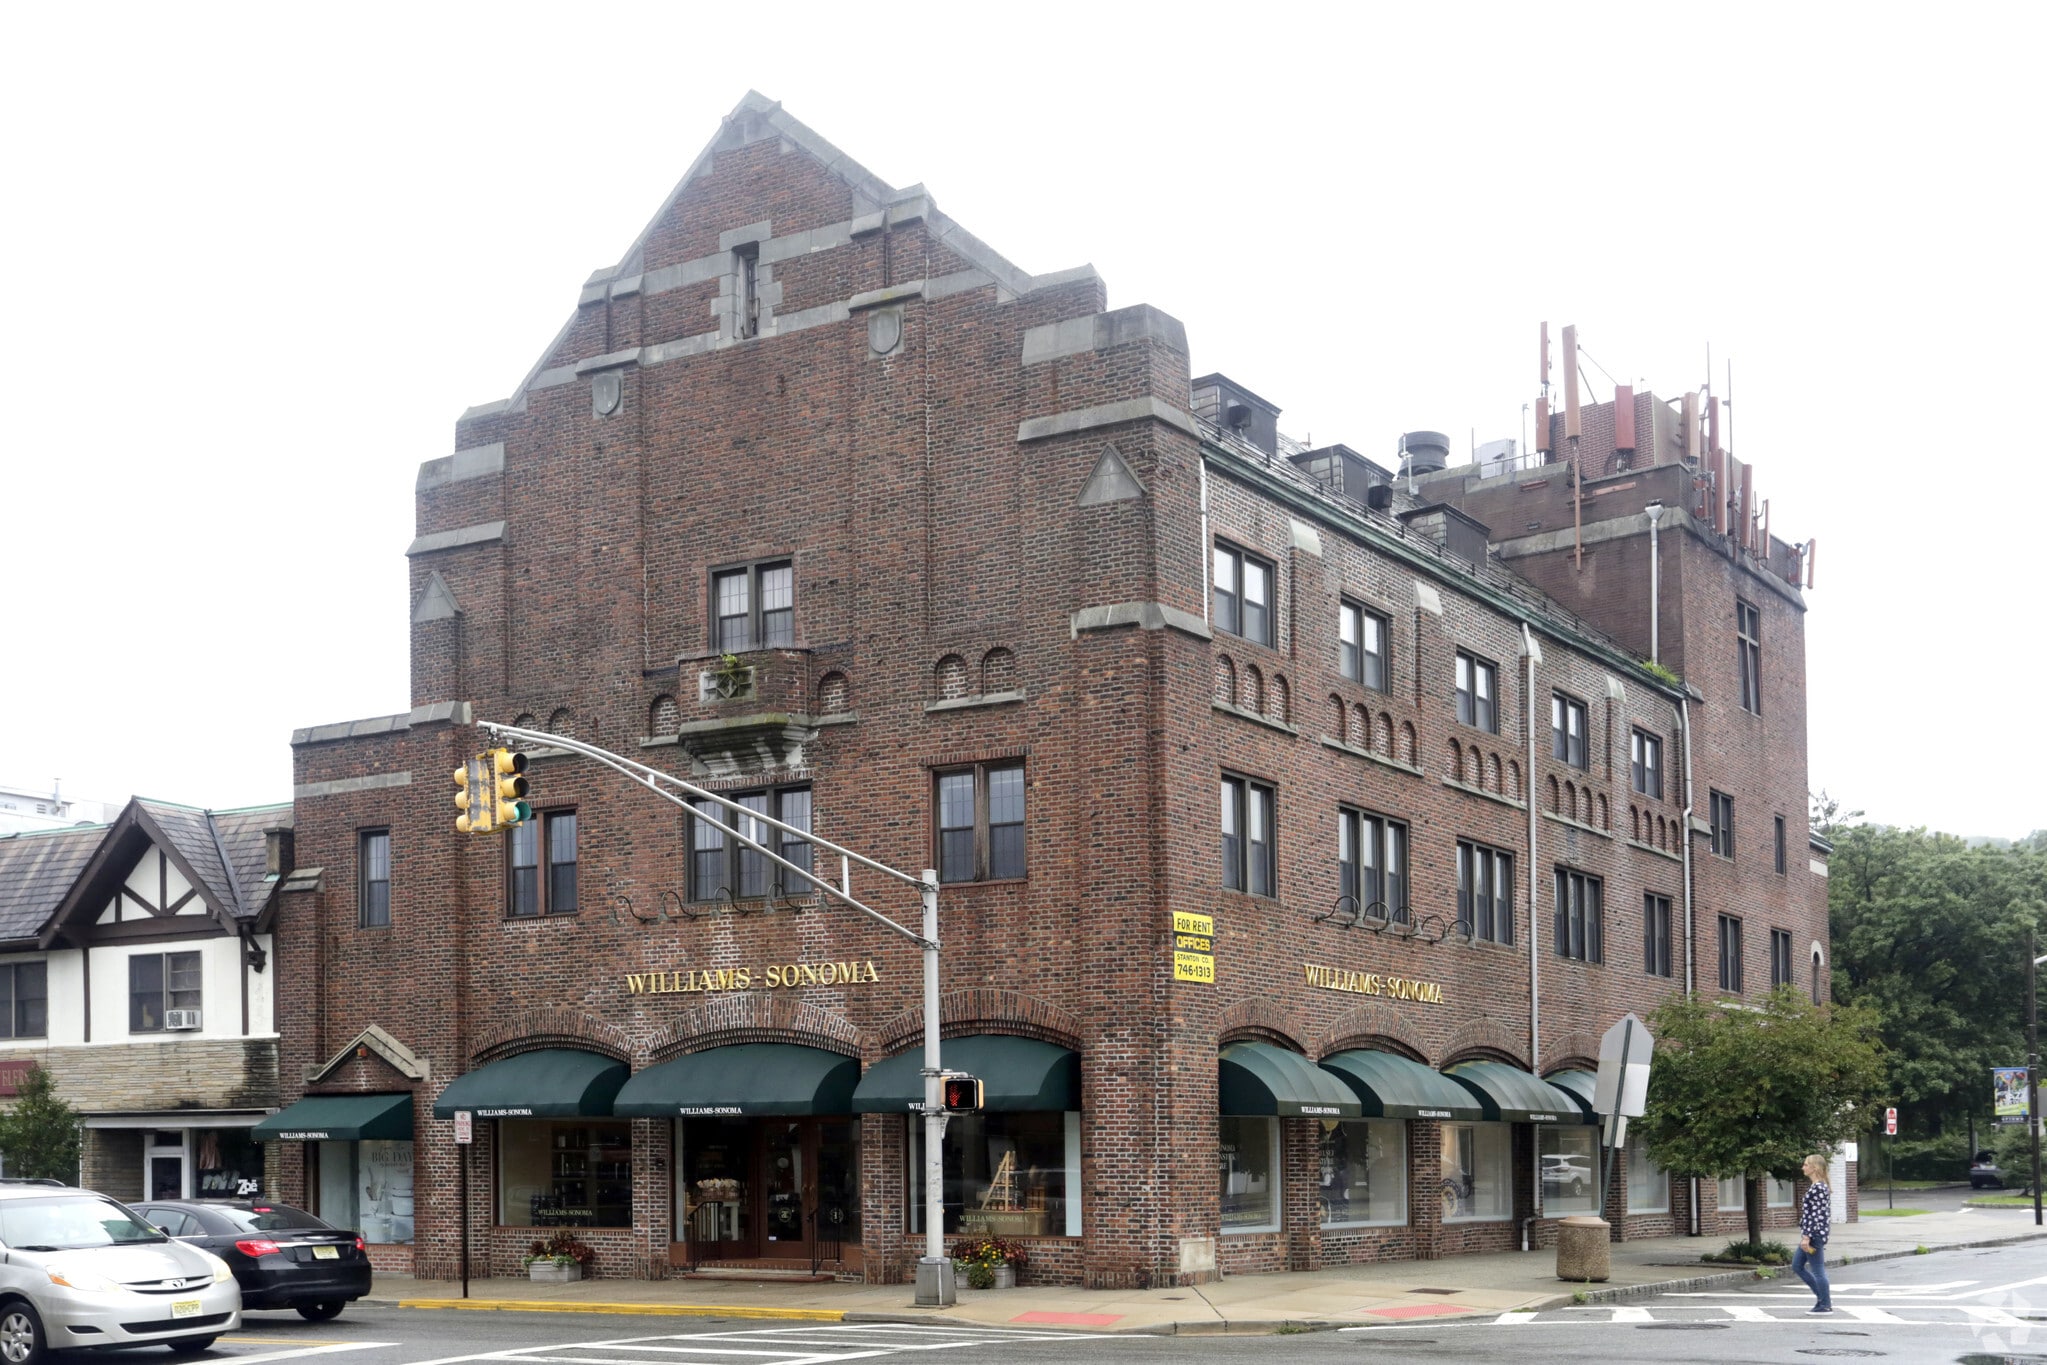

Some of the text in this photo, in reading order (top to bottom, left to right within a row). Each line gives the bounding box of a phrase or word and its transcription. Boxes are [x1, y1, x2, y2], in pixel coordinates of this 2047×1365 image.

[1177, 918, 1211, 933] FOR RENT
[1176, 935, 1211, 952] OFFICES
[1177, 953, 1200, 963] STANTON
[1303, 963, 1444, 1004] WILLIAMS-SONOMA
[477, 1108, 532, 1116] WILLIAMS-SONOMA
[679, 1106, 742, 1115] WILLIAMS-SONOMA
[279, 1131, 329, 1139] WILLIAMS-SONOMA
